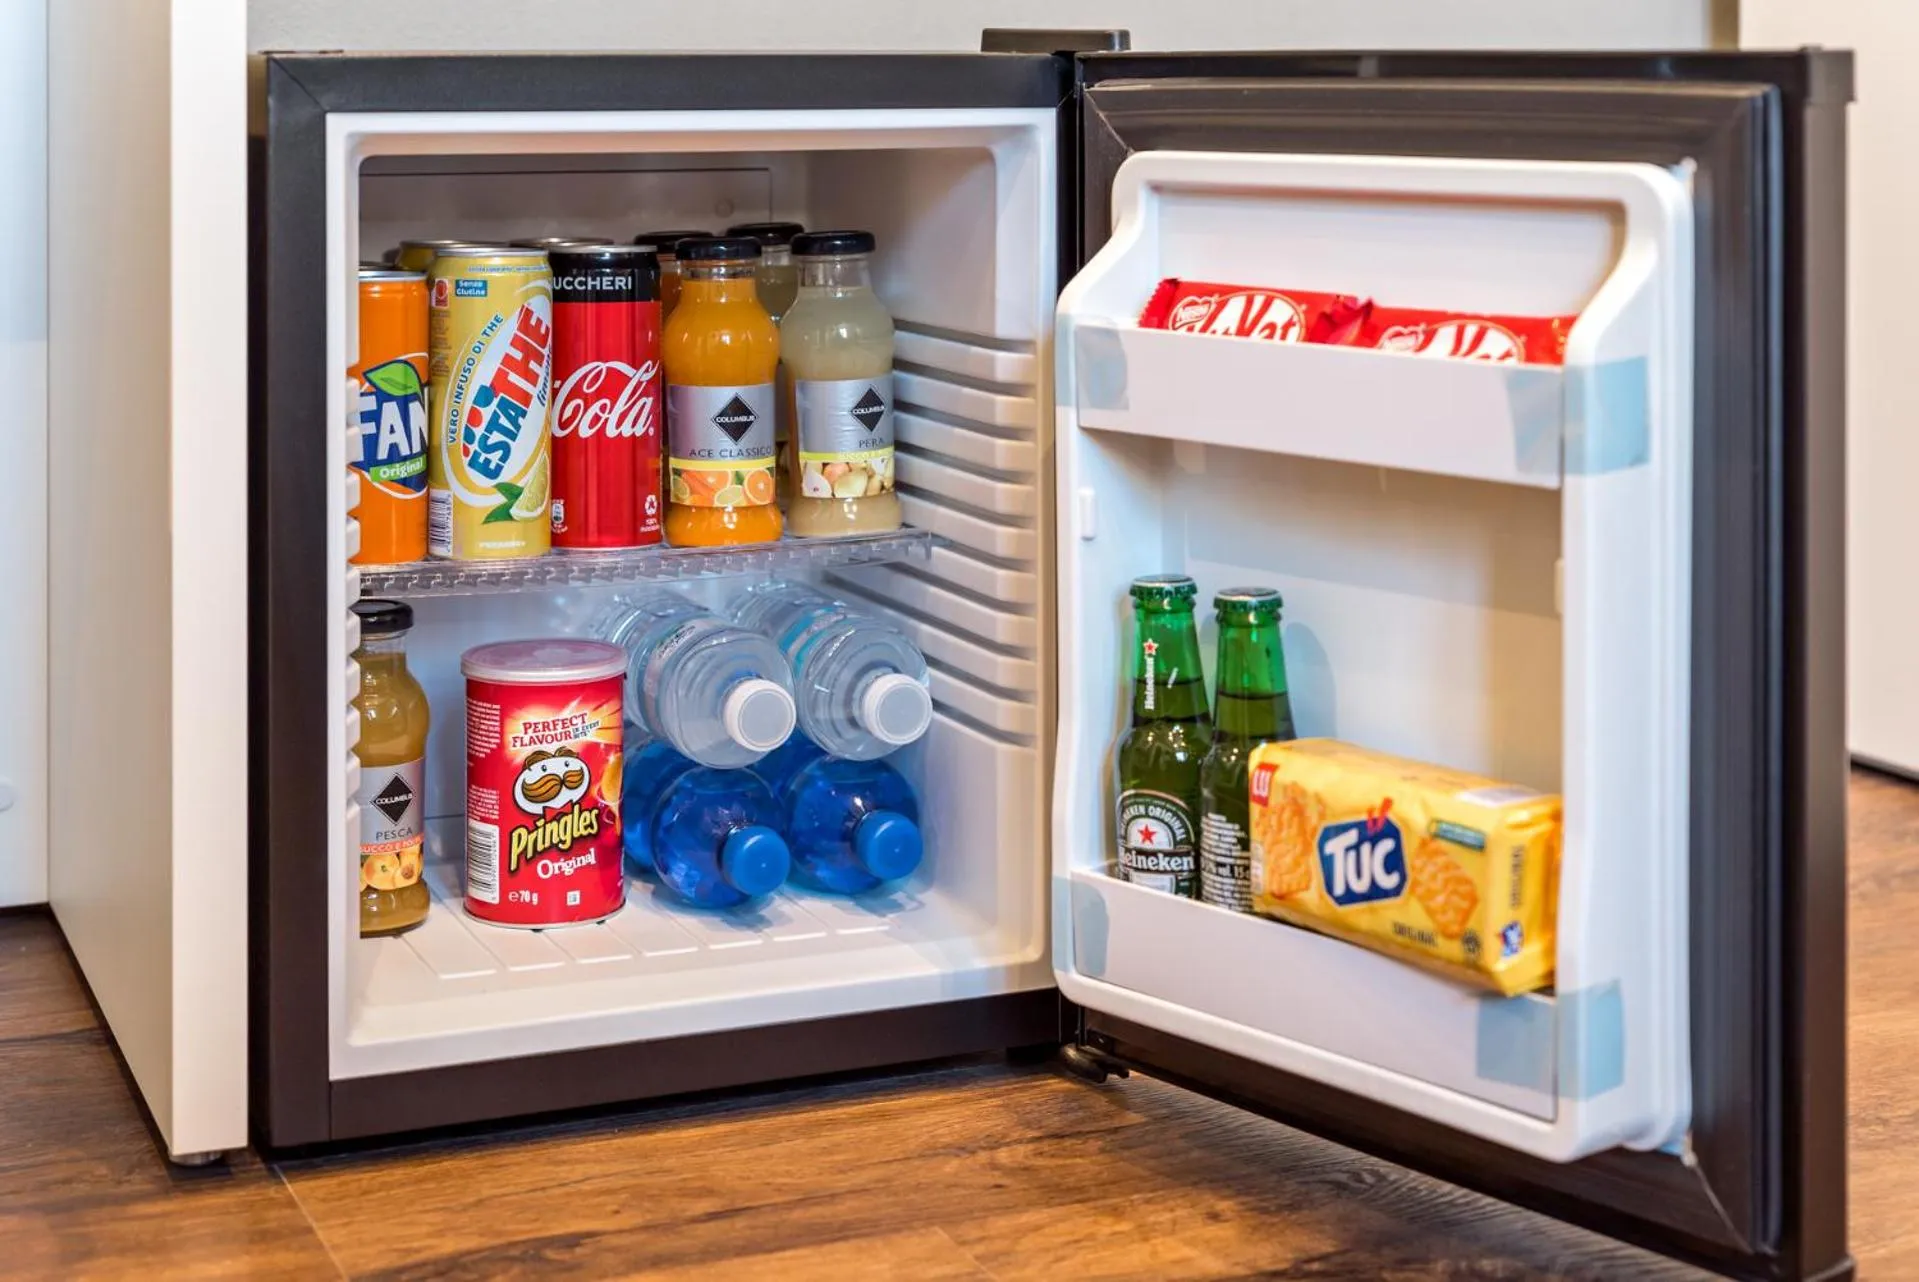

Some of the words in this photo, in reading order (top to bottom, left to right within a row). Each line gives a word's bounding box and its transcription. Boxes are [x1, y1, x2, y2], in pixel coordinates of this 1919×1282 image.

[481, 314, 503, 338] THE
[472, 340, 485, 356] DI
[454, 357, 476, 406] INFUSO
[449, 410, 460, 444] VERO
[689, 449, 714, 458] ACE
[718, 446, 773, 458] CLASSICO
[859, 437, 885, 449] PERA
[379, 458, 424, 478] Original
[522, 712, 588, 735] PERFECT
[511, 730, 573, 748] FLAVOUR
[376, 827, 413, 841] PESCA
[1148, 805, 1187, 841] ORIGINAL
[510, 803, 600, 873] Pringles
[536, 847, 597, 880] Original
